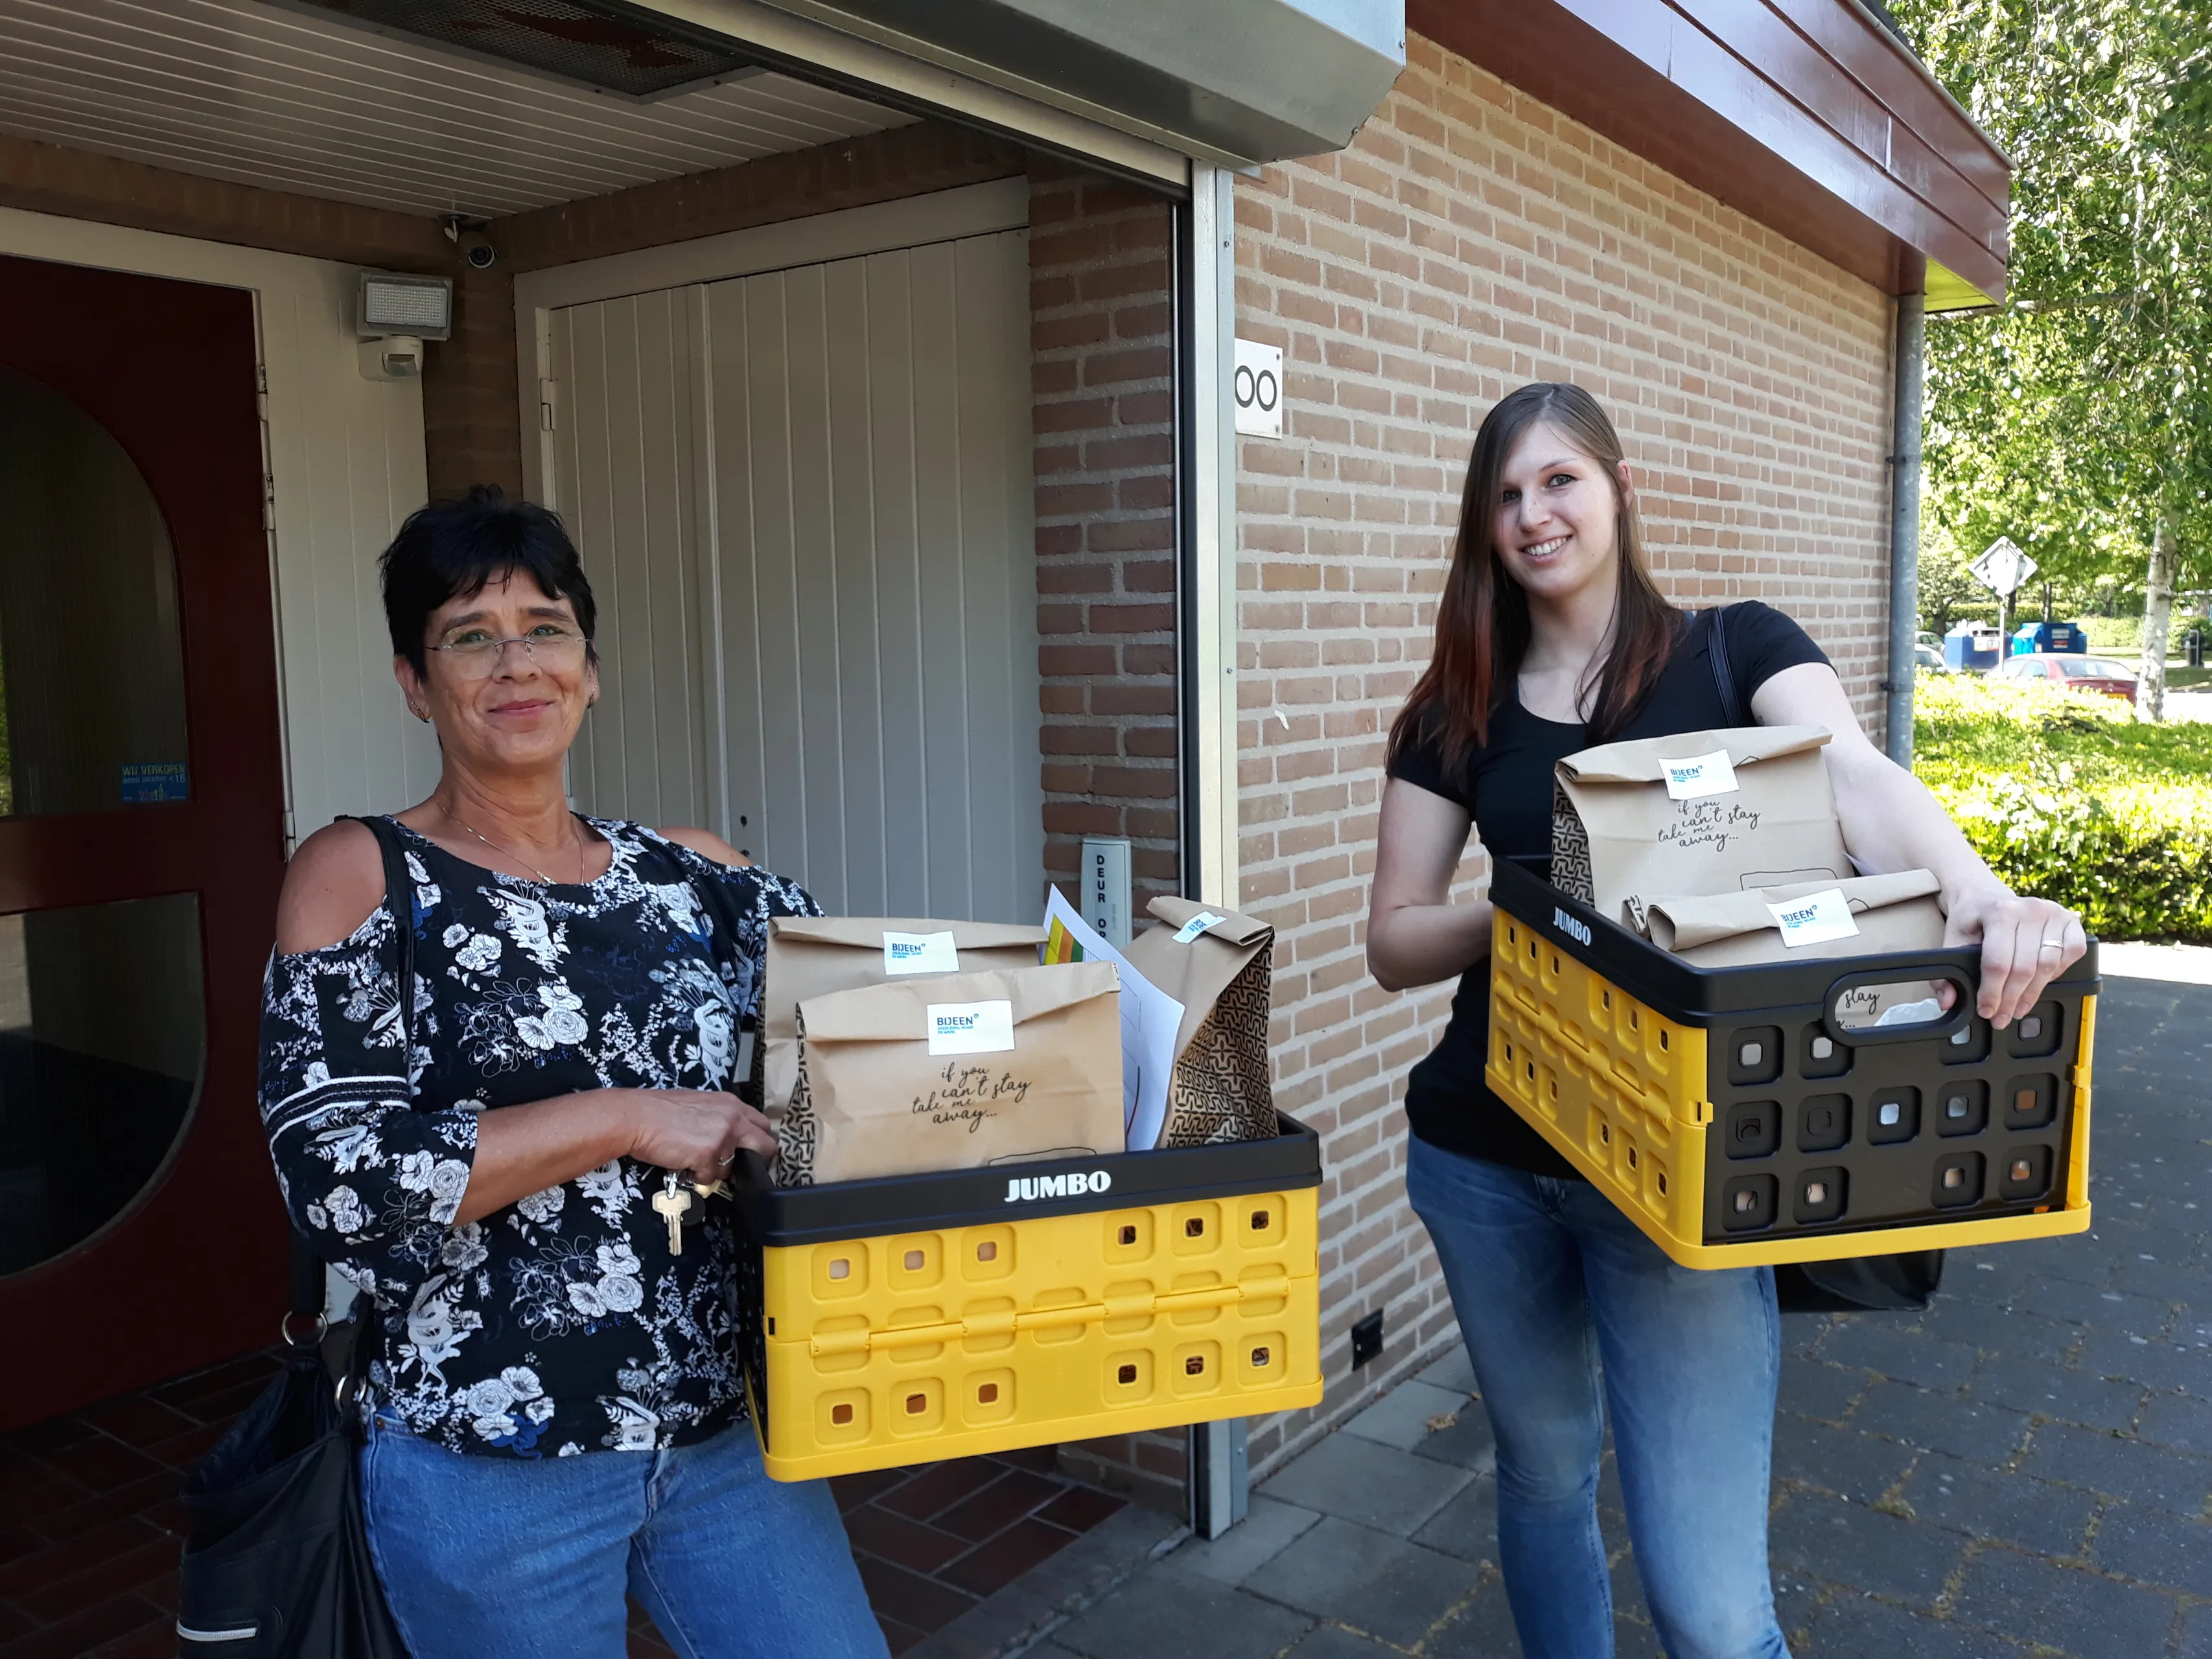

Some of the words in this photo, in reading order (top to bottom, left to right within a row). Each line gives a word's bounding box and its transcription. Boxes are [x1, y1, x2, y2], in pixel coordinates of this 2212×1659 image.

[141, 765, 185, 775] VERKOPEN
[1678, 799, 1689, 815] if
[1695, 800, 1720, 818] you
[1682, 807, 1722, 828] can't
[1728, 804, 1761, 830] stay
[1658, 823, 1686, 842] take
[1694, 824, 1714, 833] me
[1097, 855, 1106, 903] DEUR
[1553, 907, 1591, 946] JUMBO
[1781, 909, 1814, 922] BIJEEN
[892, 943, 922, 952] BIJEEN
[937, 1016, 973, 1026] BIJEEN
[942, 1062, 955, 1082] if
[959, 1067, 990, 1087] you
[942, 1075, 989, 1098] can't
[992, 1073, 1032, 1103] stay
[913, 1091, 944, 1114] take
[951, 1098, 976, 1108] me
[1005, 1170, 1112, 1202] JUMBO
